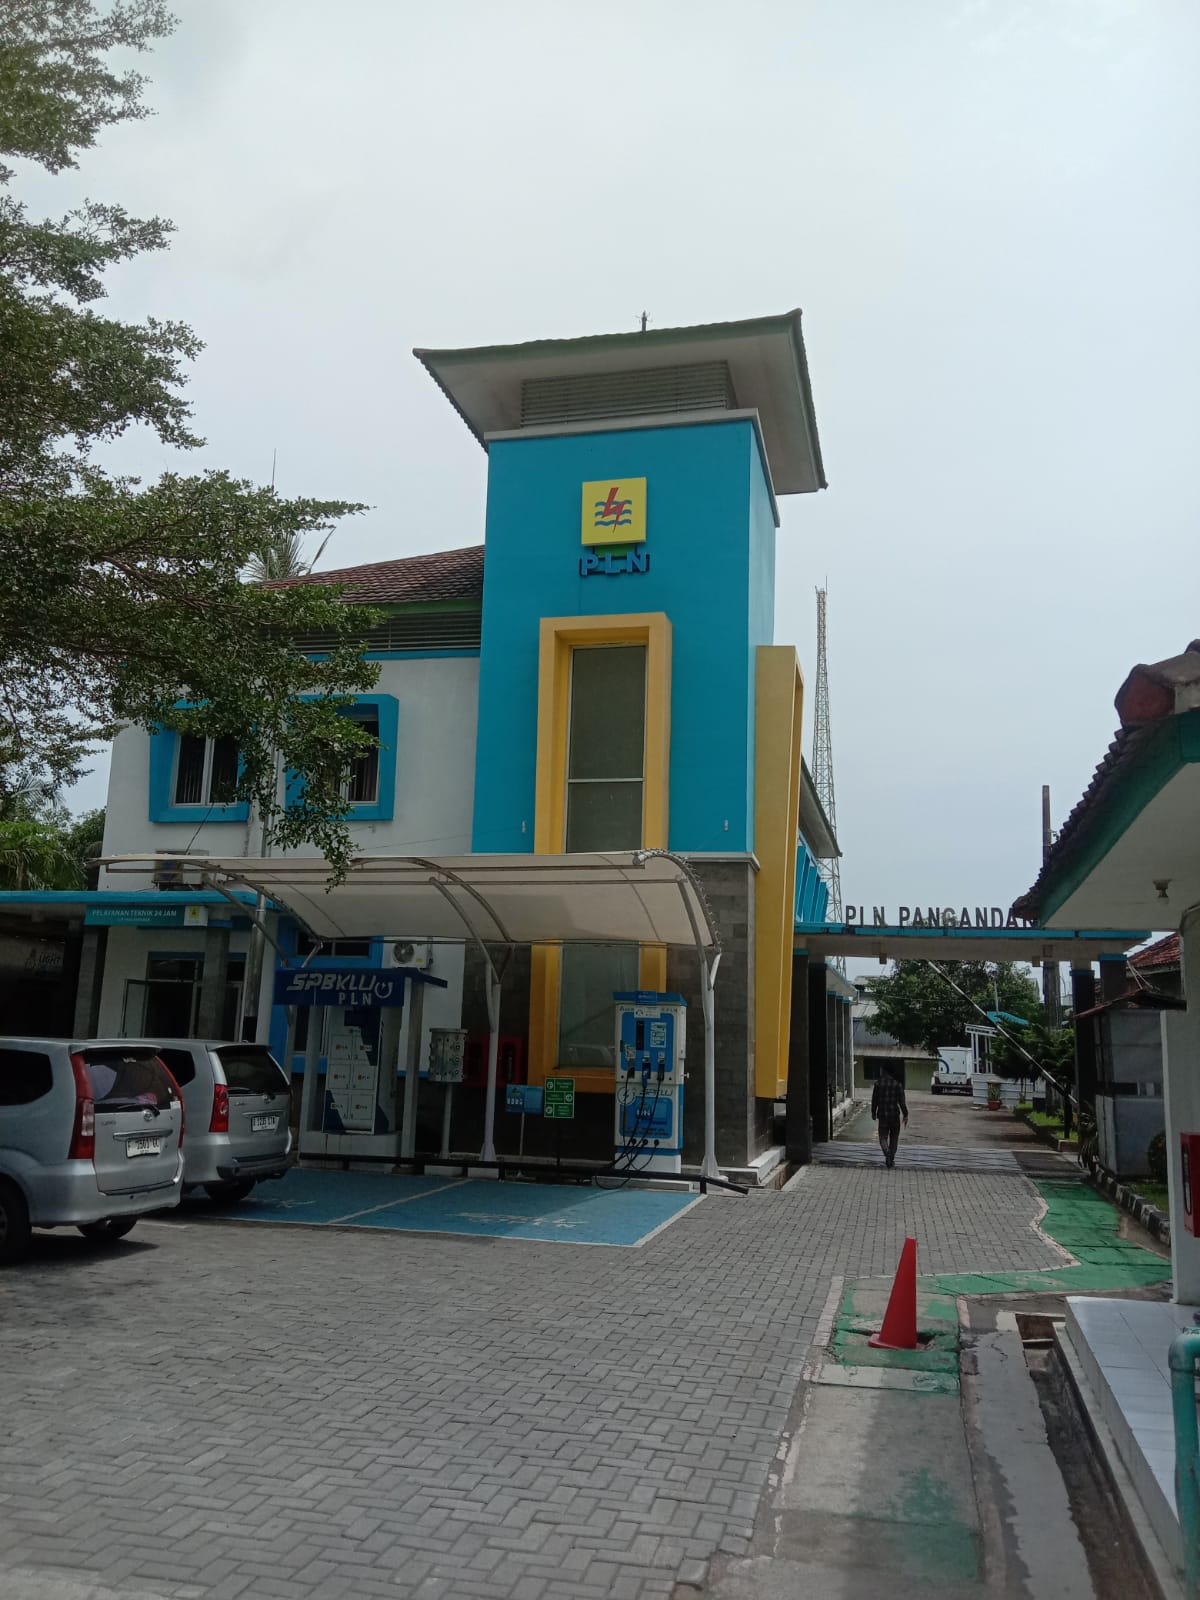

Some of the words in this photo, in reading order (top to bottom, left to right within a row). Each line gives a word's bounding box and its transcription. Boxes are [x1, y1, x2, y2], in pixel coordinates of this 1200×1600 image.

[581, 551, 647, 576] PLN
[92, 909, 129, 917] PELAYANAN
[131, 909, 153, 917] TEKNIK
[286, 973, 377, 991] SPBKLU
[338, 991, 372, 1005] PLN
